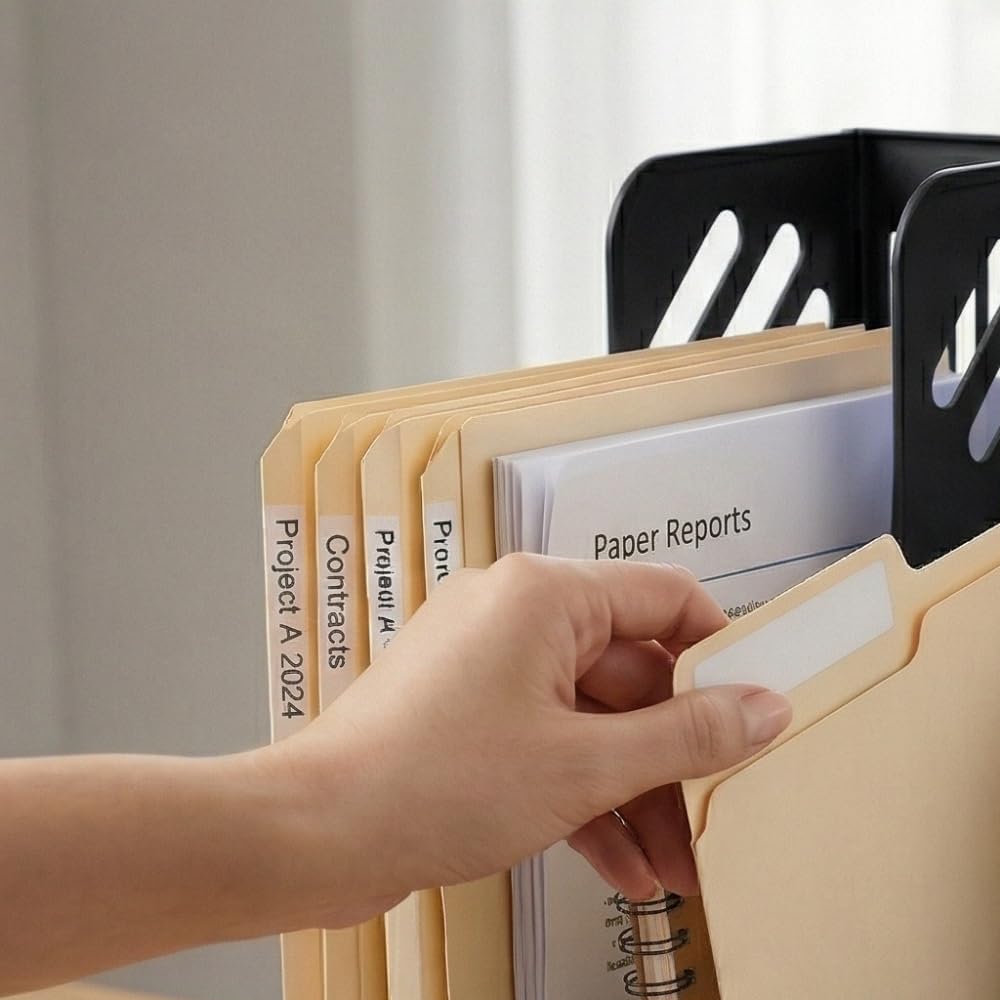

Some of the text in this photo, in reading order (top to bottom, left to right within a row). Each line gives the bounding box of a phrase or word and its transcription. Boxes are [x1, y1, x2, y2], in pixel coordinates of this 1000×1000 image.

[594, 507, 751, 560] Paper Reports
[272, 519, 305, 719] Project A 2024
[325, 534, 352, 669] Contracts
